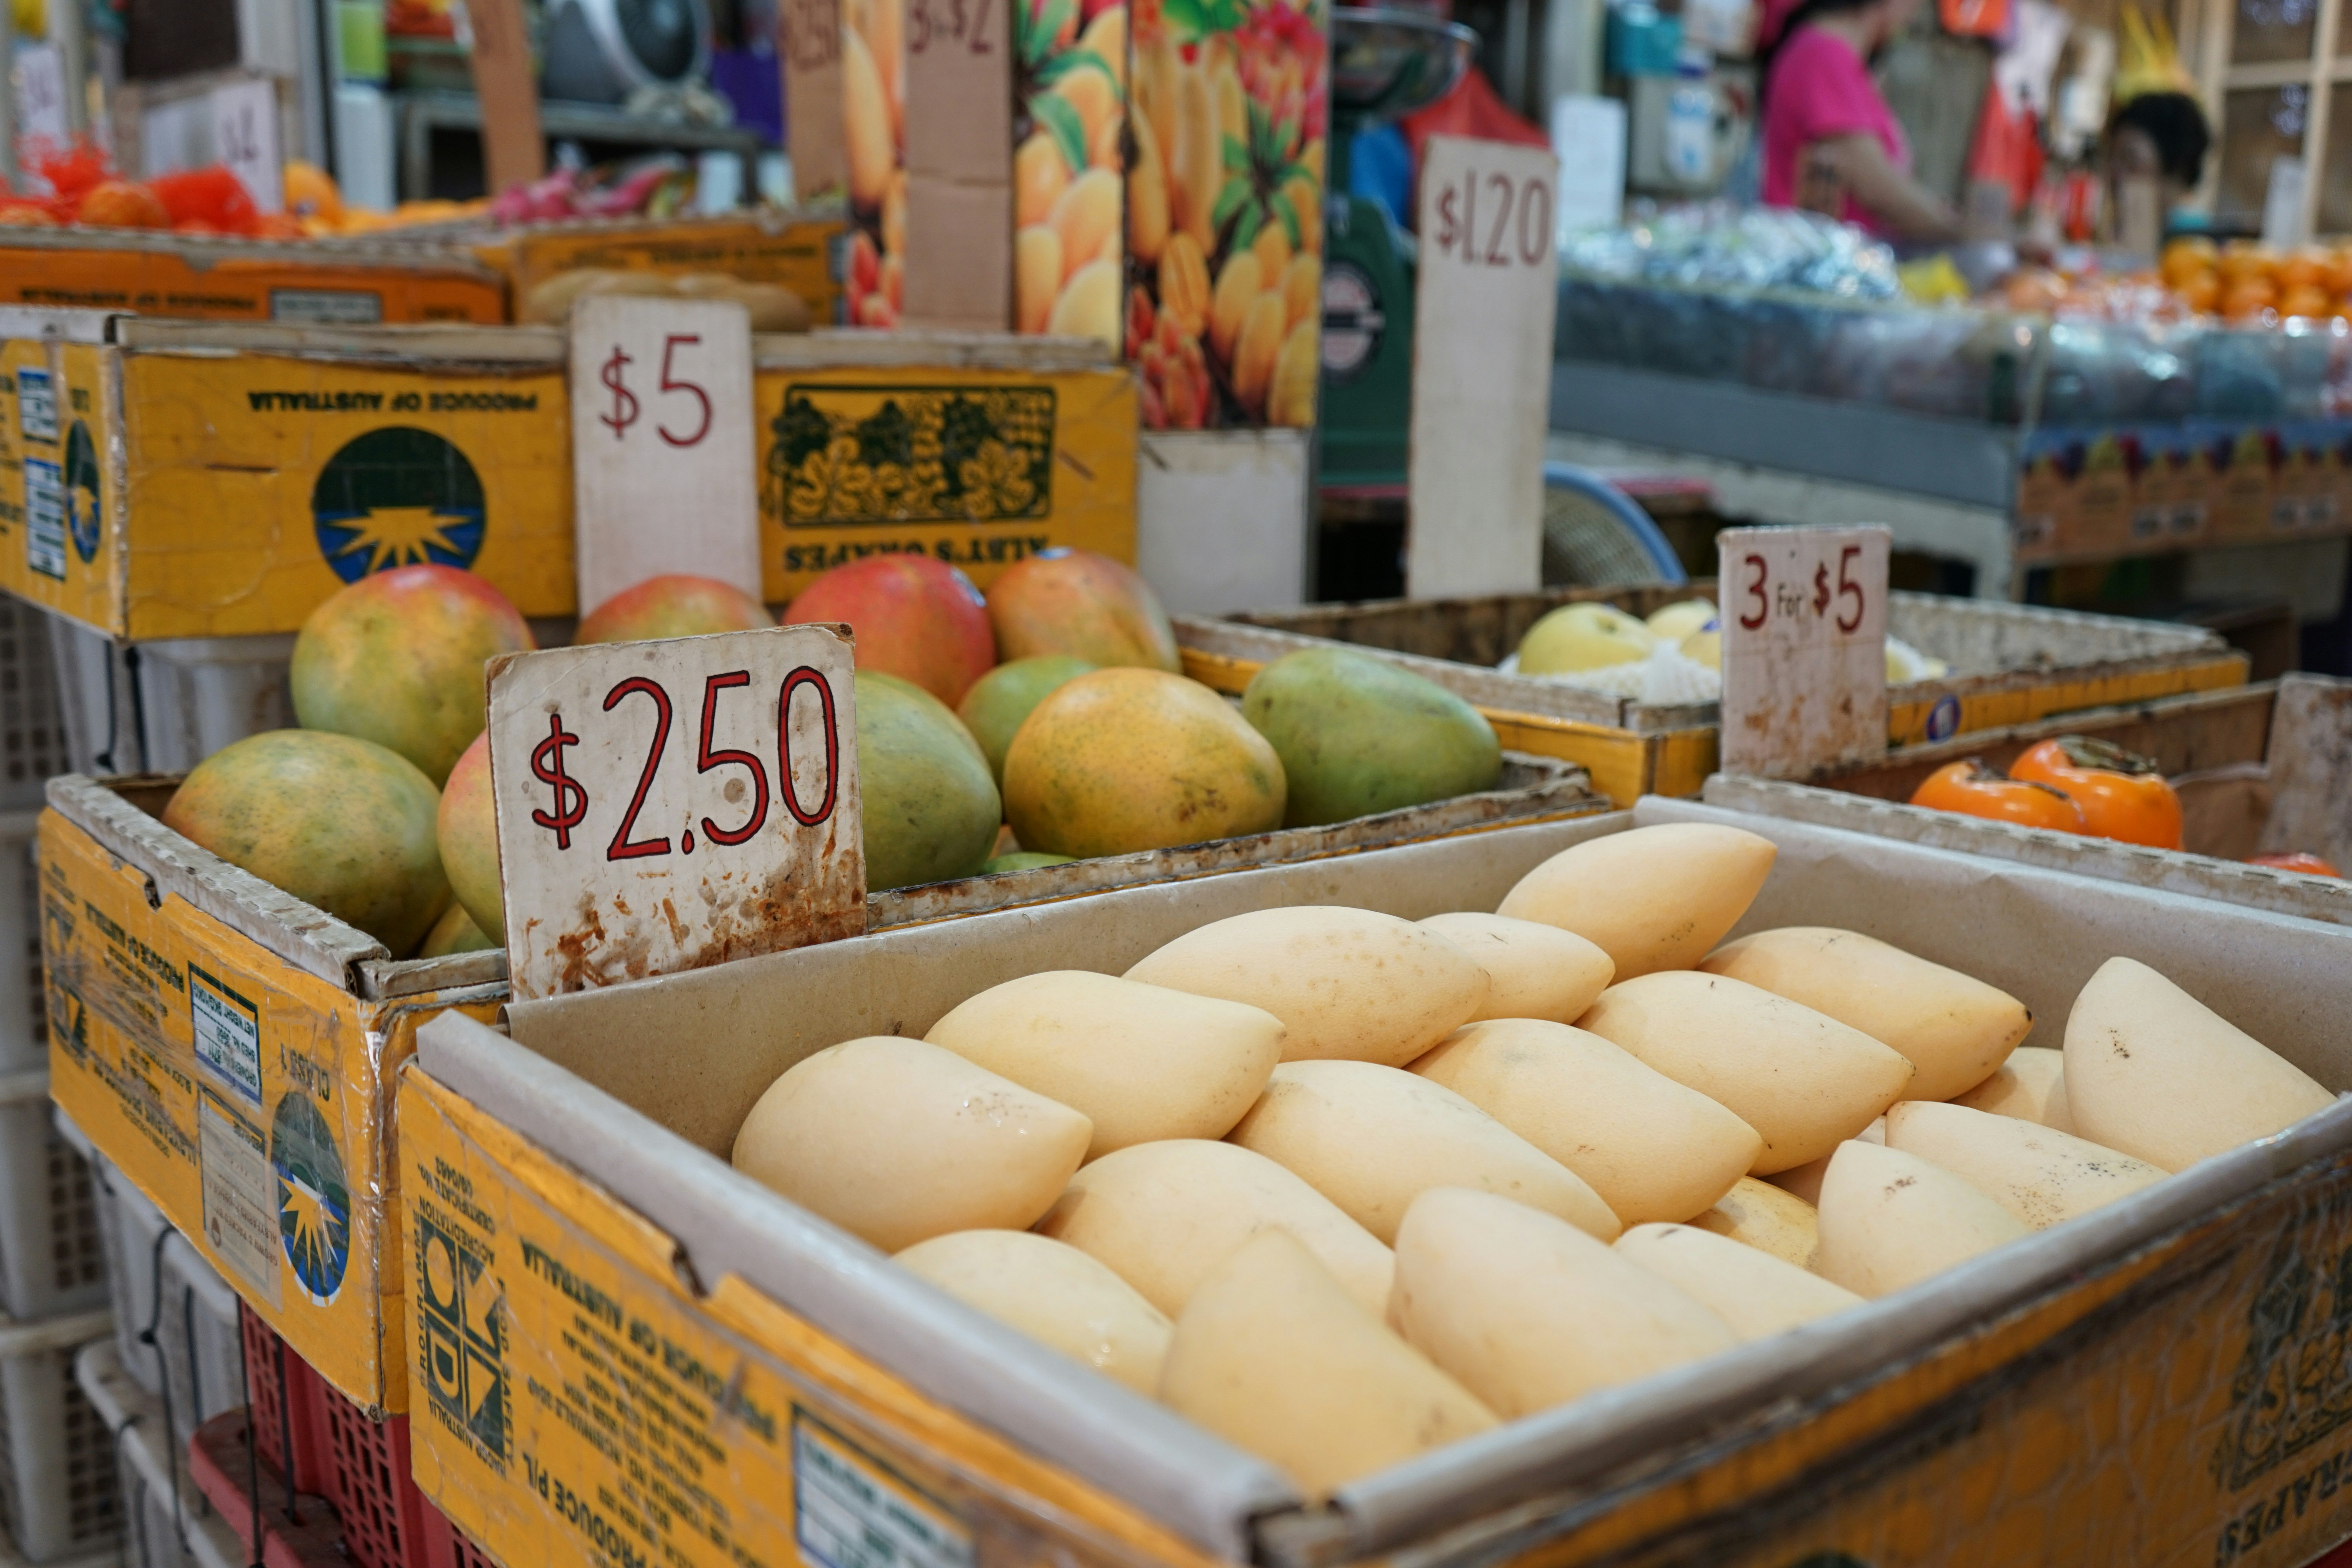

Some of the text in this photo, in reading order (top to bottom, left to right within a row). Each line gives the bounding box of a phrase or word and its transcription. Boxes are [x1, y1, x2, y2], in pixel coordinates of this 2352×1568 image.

[247, 392, 538, 412] PRODUCE OF AUSTRALIA
[601, 335, 713, 448] $5
[1740, 551, 1768, 630] 3
[1813, 546, 1865, 635] $5
[531, 665, 838, 862] $2.50
[419, 1195, 495, 1267] ACCREDITATION
[412, 1209, 428, 1391] PROGRAMME
[520, 1236, 622, 1334] AUSTRALIA
[428, 1396, 473, 1452] AUSTRALIA
